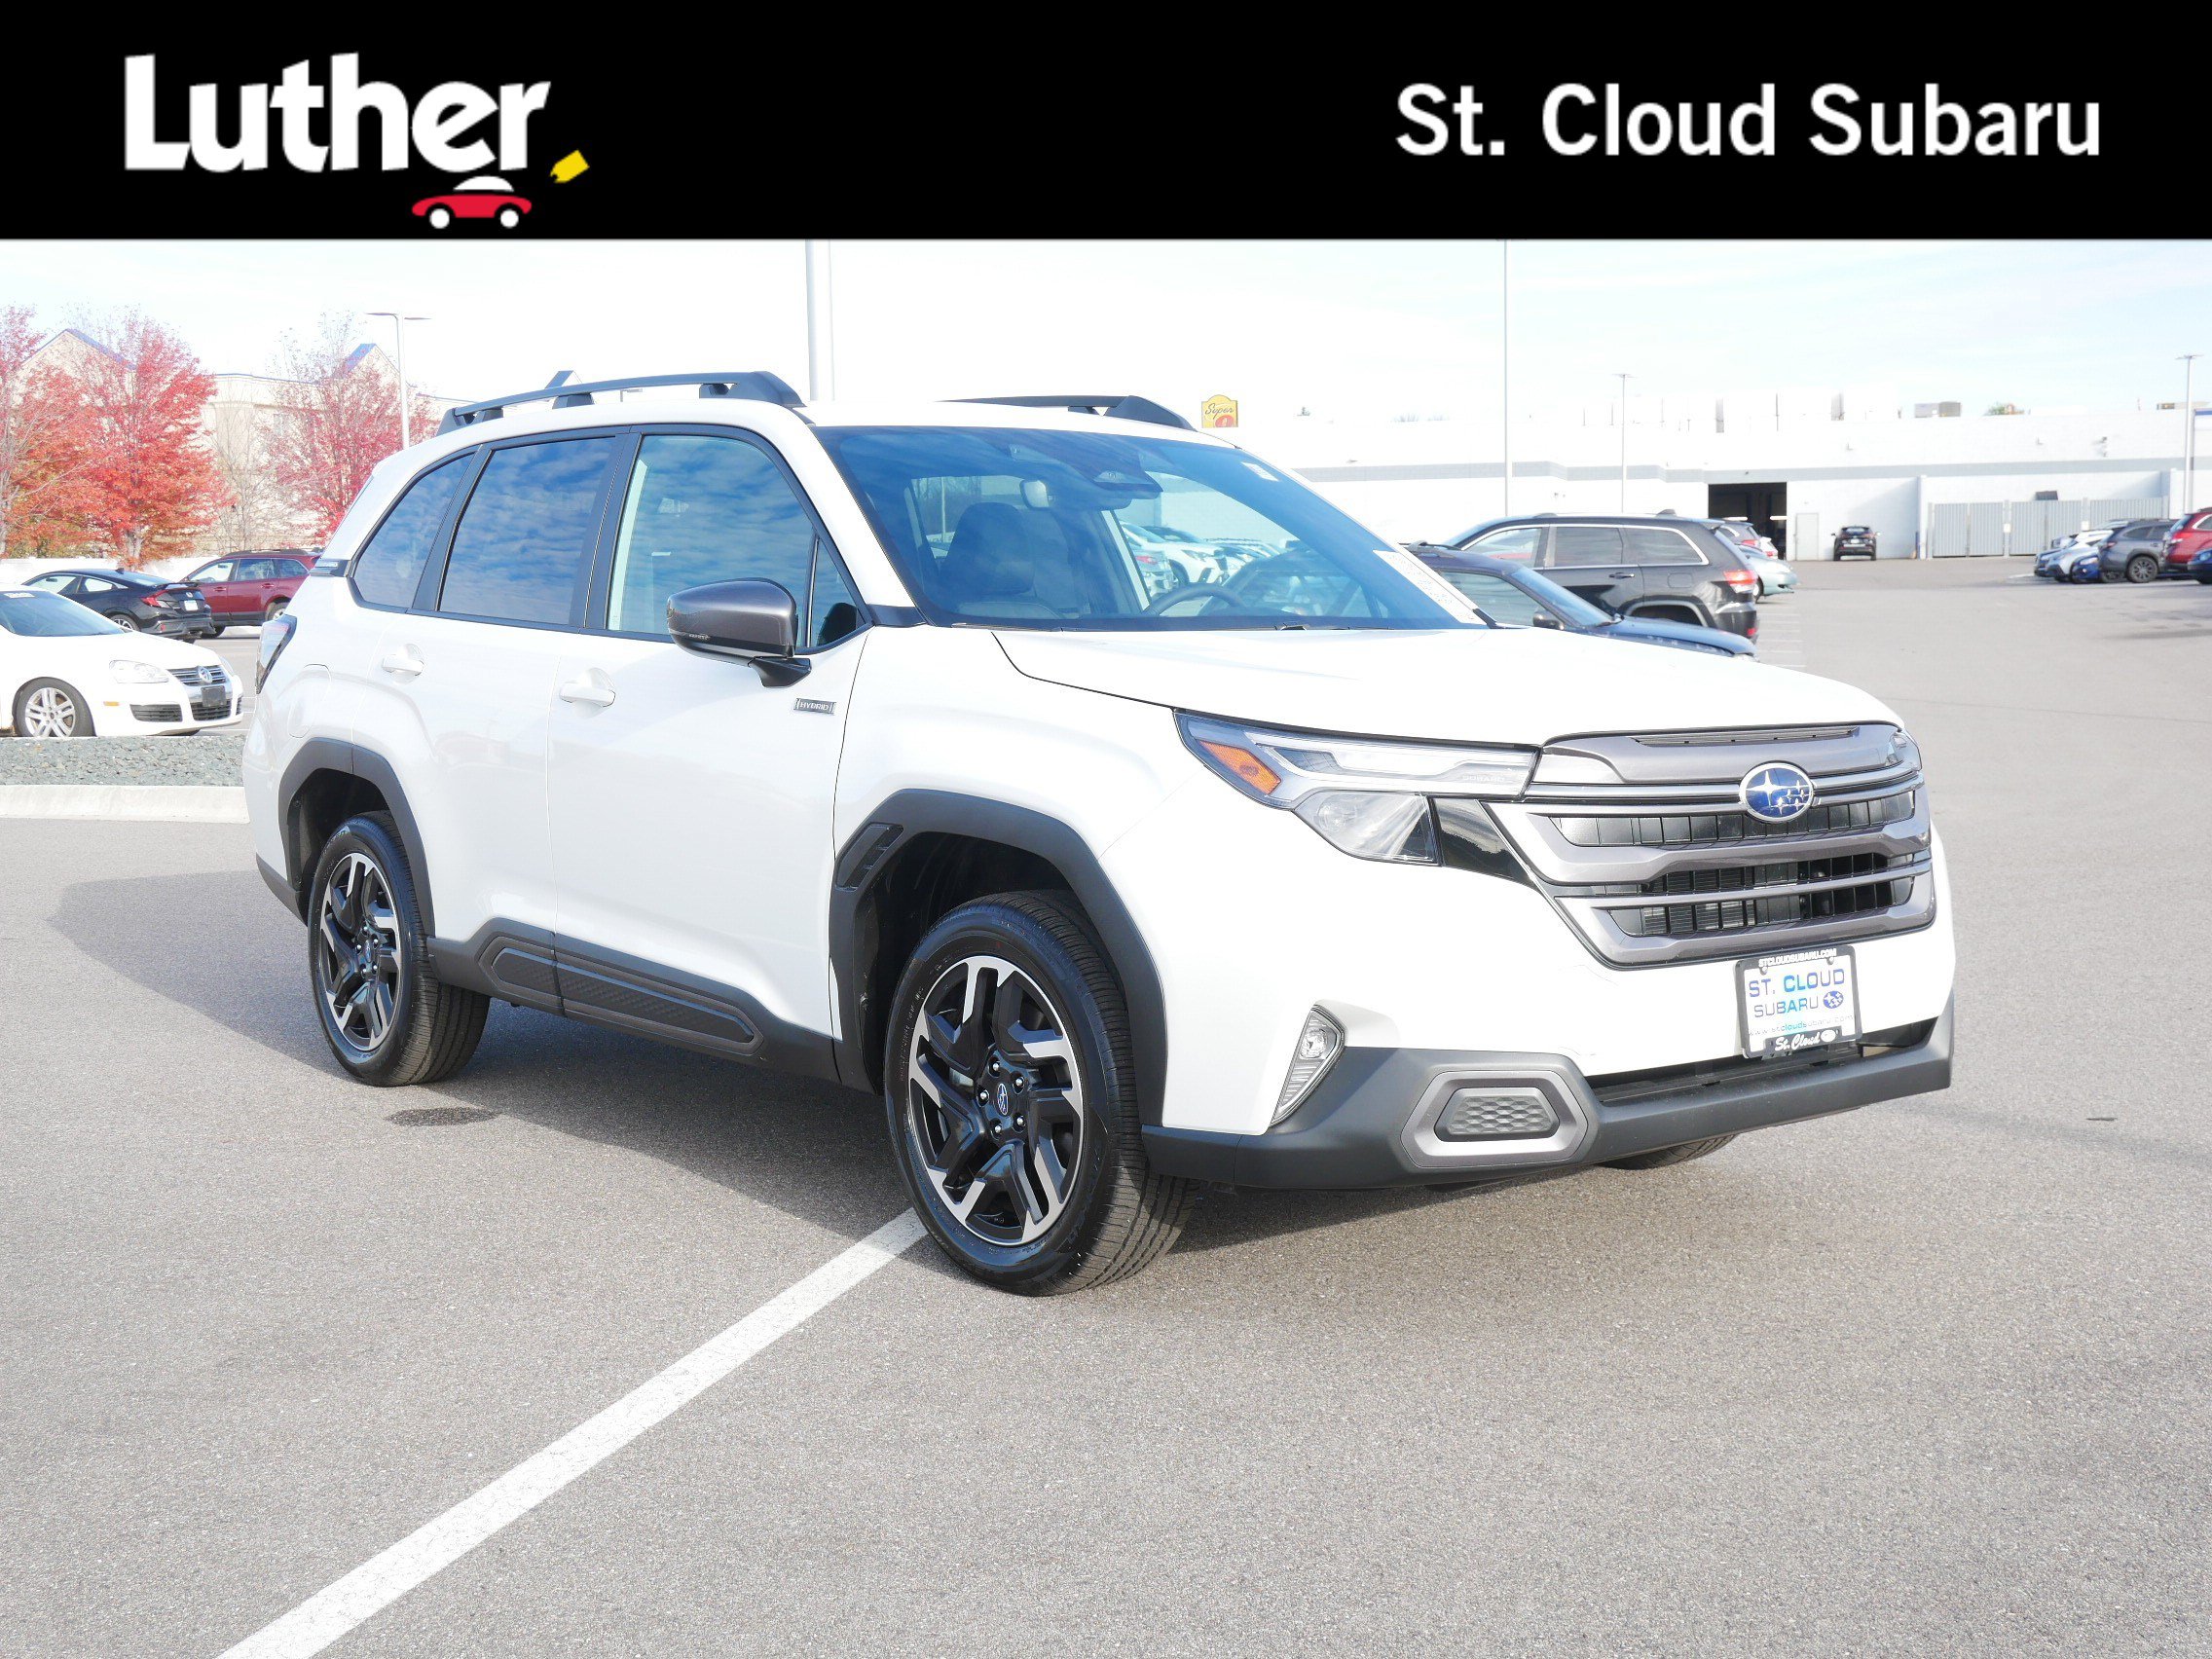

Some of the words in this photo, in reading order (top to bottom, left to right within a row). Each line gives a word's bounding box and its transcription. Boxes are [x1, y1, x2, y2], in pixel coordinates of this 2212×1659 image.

[1204, 403, 1234, 421] Super
[1749, 978, 1776, 998] ST.
[1784, 968, 1845, 993] CLOUD
[1753, 995, 1819, 1018] SUBARU
[1774, 1036, 1790, 1051] St.
[1790, 1032, 1821, 1051] Cloud
